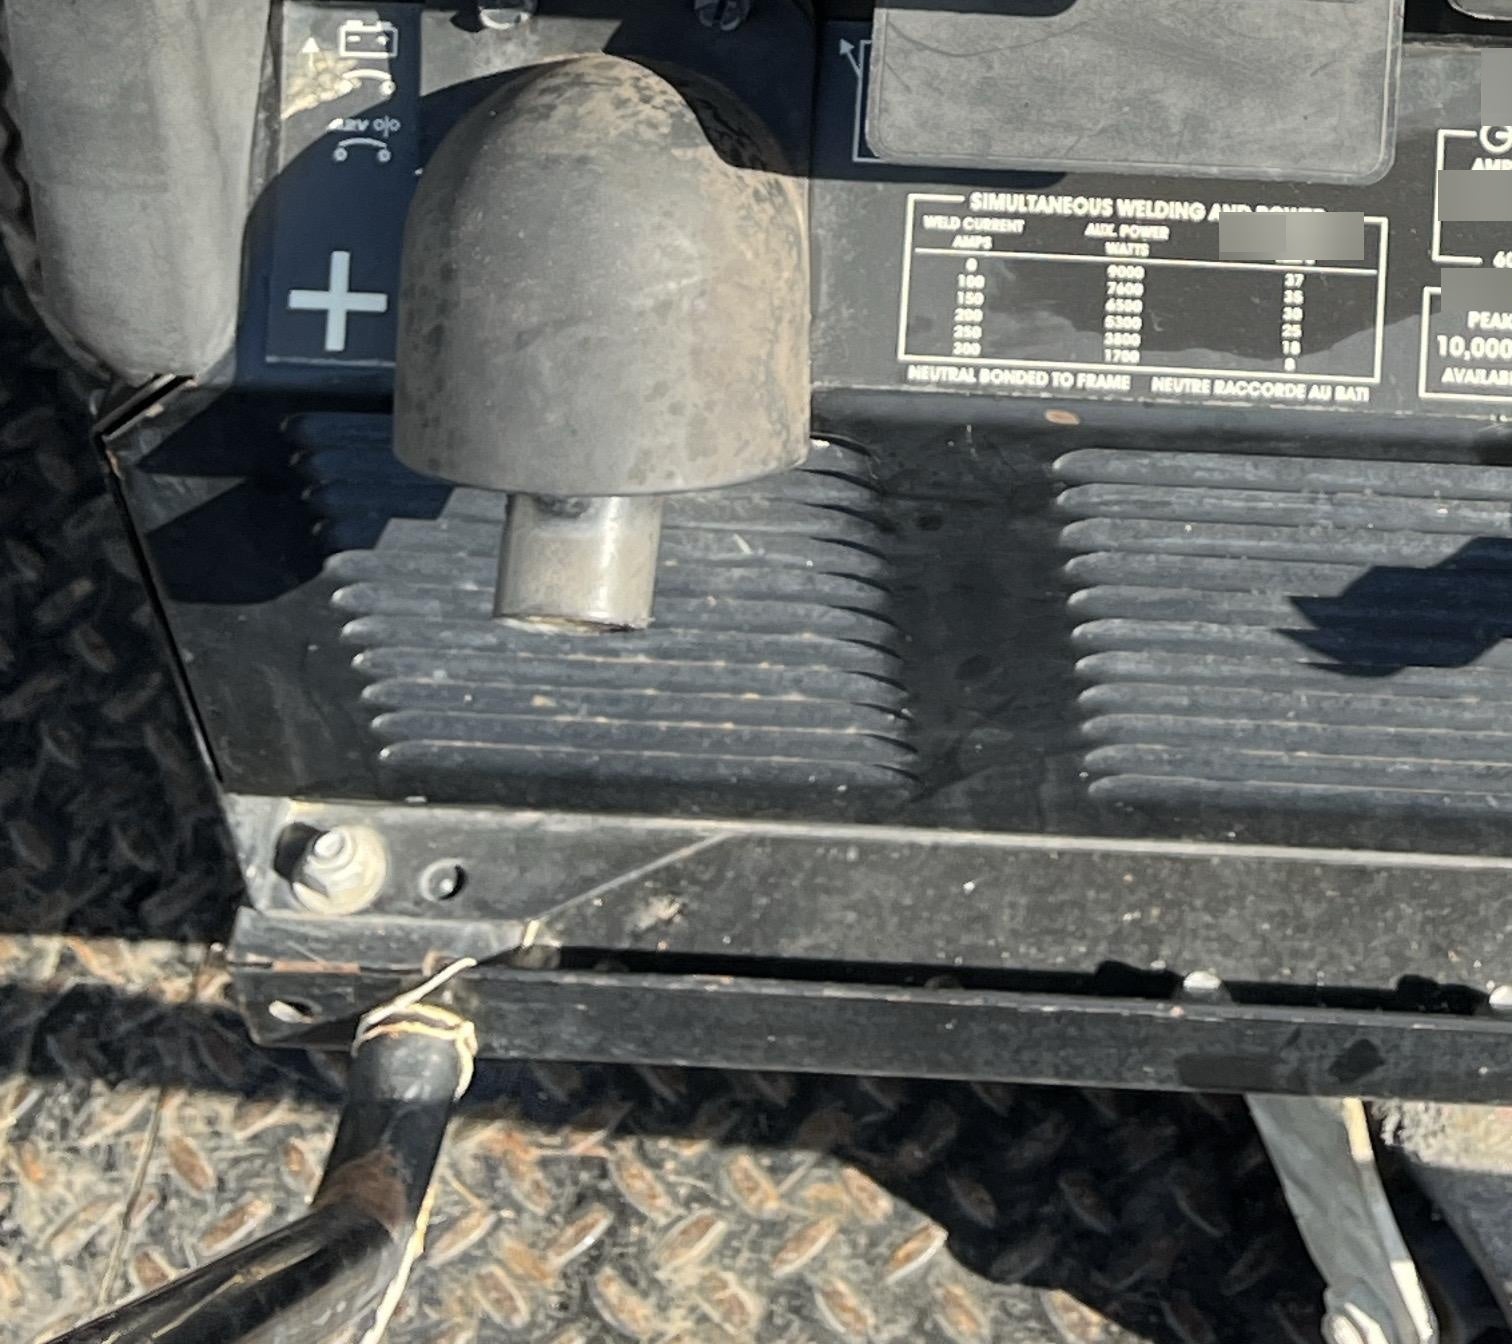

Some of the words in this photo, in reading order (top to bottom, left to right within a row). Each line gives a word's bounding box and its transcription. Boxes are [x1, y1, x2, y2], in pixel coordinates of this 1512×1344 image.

[969, 191, 1114, 218] SIMULTANEOUS
[1115, 199, 1207, 223] WELDING
[922, 214, 961, 231] WELD
[962, 216, 1026, 234] CURRENT
[1118, 223, 1171, 242] POWER
[951, 234, 993, 250] AMPS
[1104, 241, 1150, 258] WATTS
[1284, 272, 1305, 289] 37
[906, 364, 977, 383] NEUTRAL
[978, 367, 1050, 388] BONDED
[1051, 370, 1075, 389] TO
[1076, 372, 1133, 391] FRAME
[1151, 376, 1211, 394] NEUTRE
[1212, 378, 1307, 400] RACCORDE
[1307, 384, 1333, 401] AU
[1333, 385, 1370, 403] BATI
